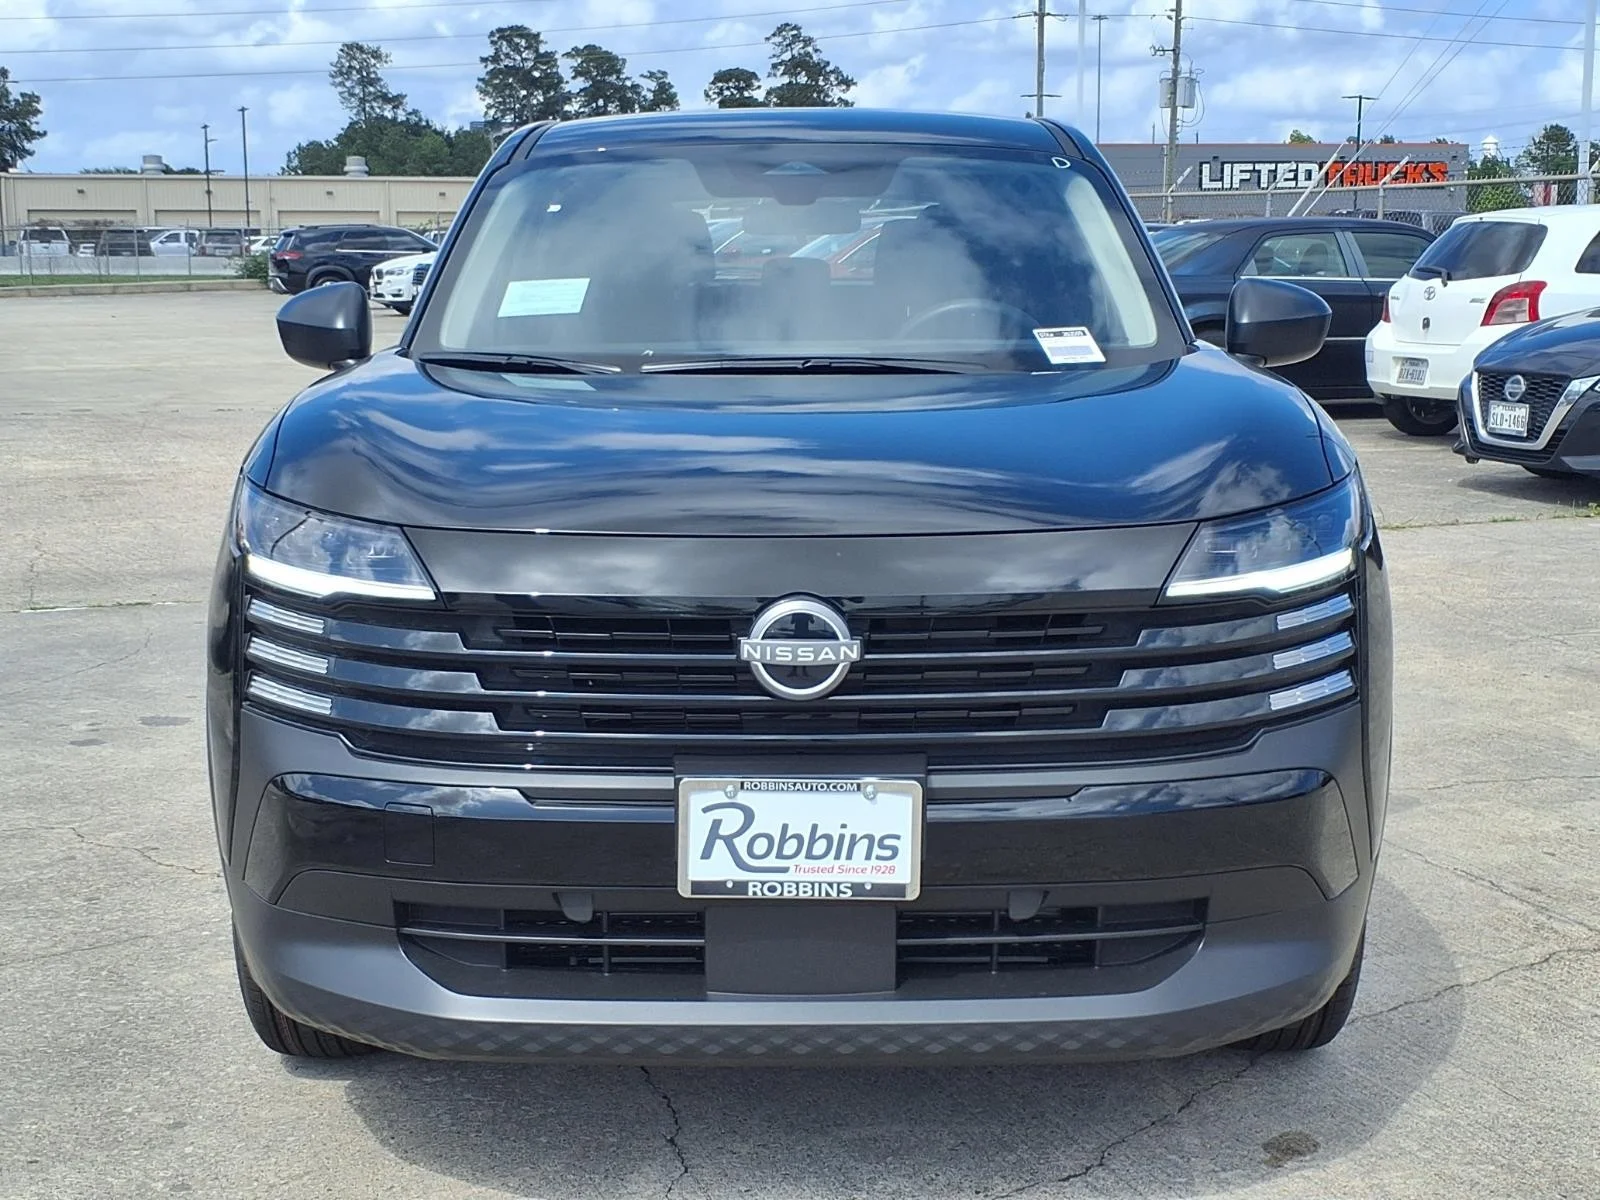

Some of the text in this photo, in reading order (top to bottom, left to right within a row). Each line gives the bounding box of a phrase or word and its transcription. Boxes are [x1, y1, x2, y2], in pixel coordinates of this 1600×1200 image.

[1201, 161, 1320, 189] LIFTED
[743, 644, 858, 661] NISSAN
[743, 781, 858, 792] ROBBINSAUTO.COM
[700, 801, 902, 874] Robbins
[793, 863, 896, 875] Trusted Since 1928
[747, 881, 853, 898] ROBBINS
